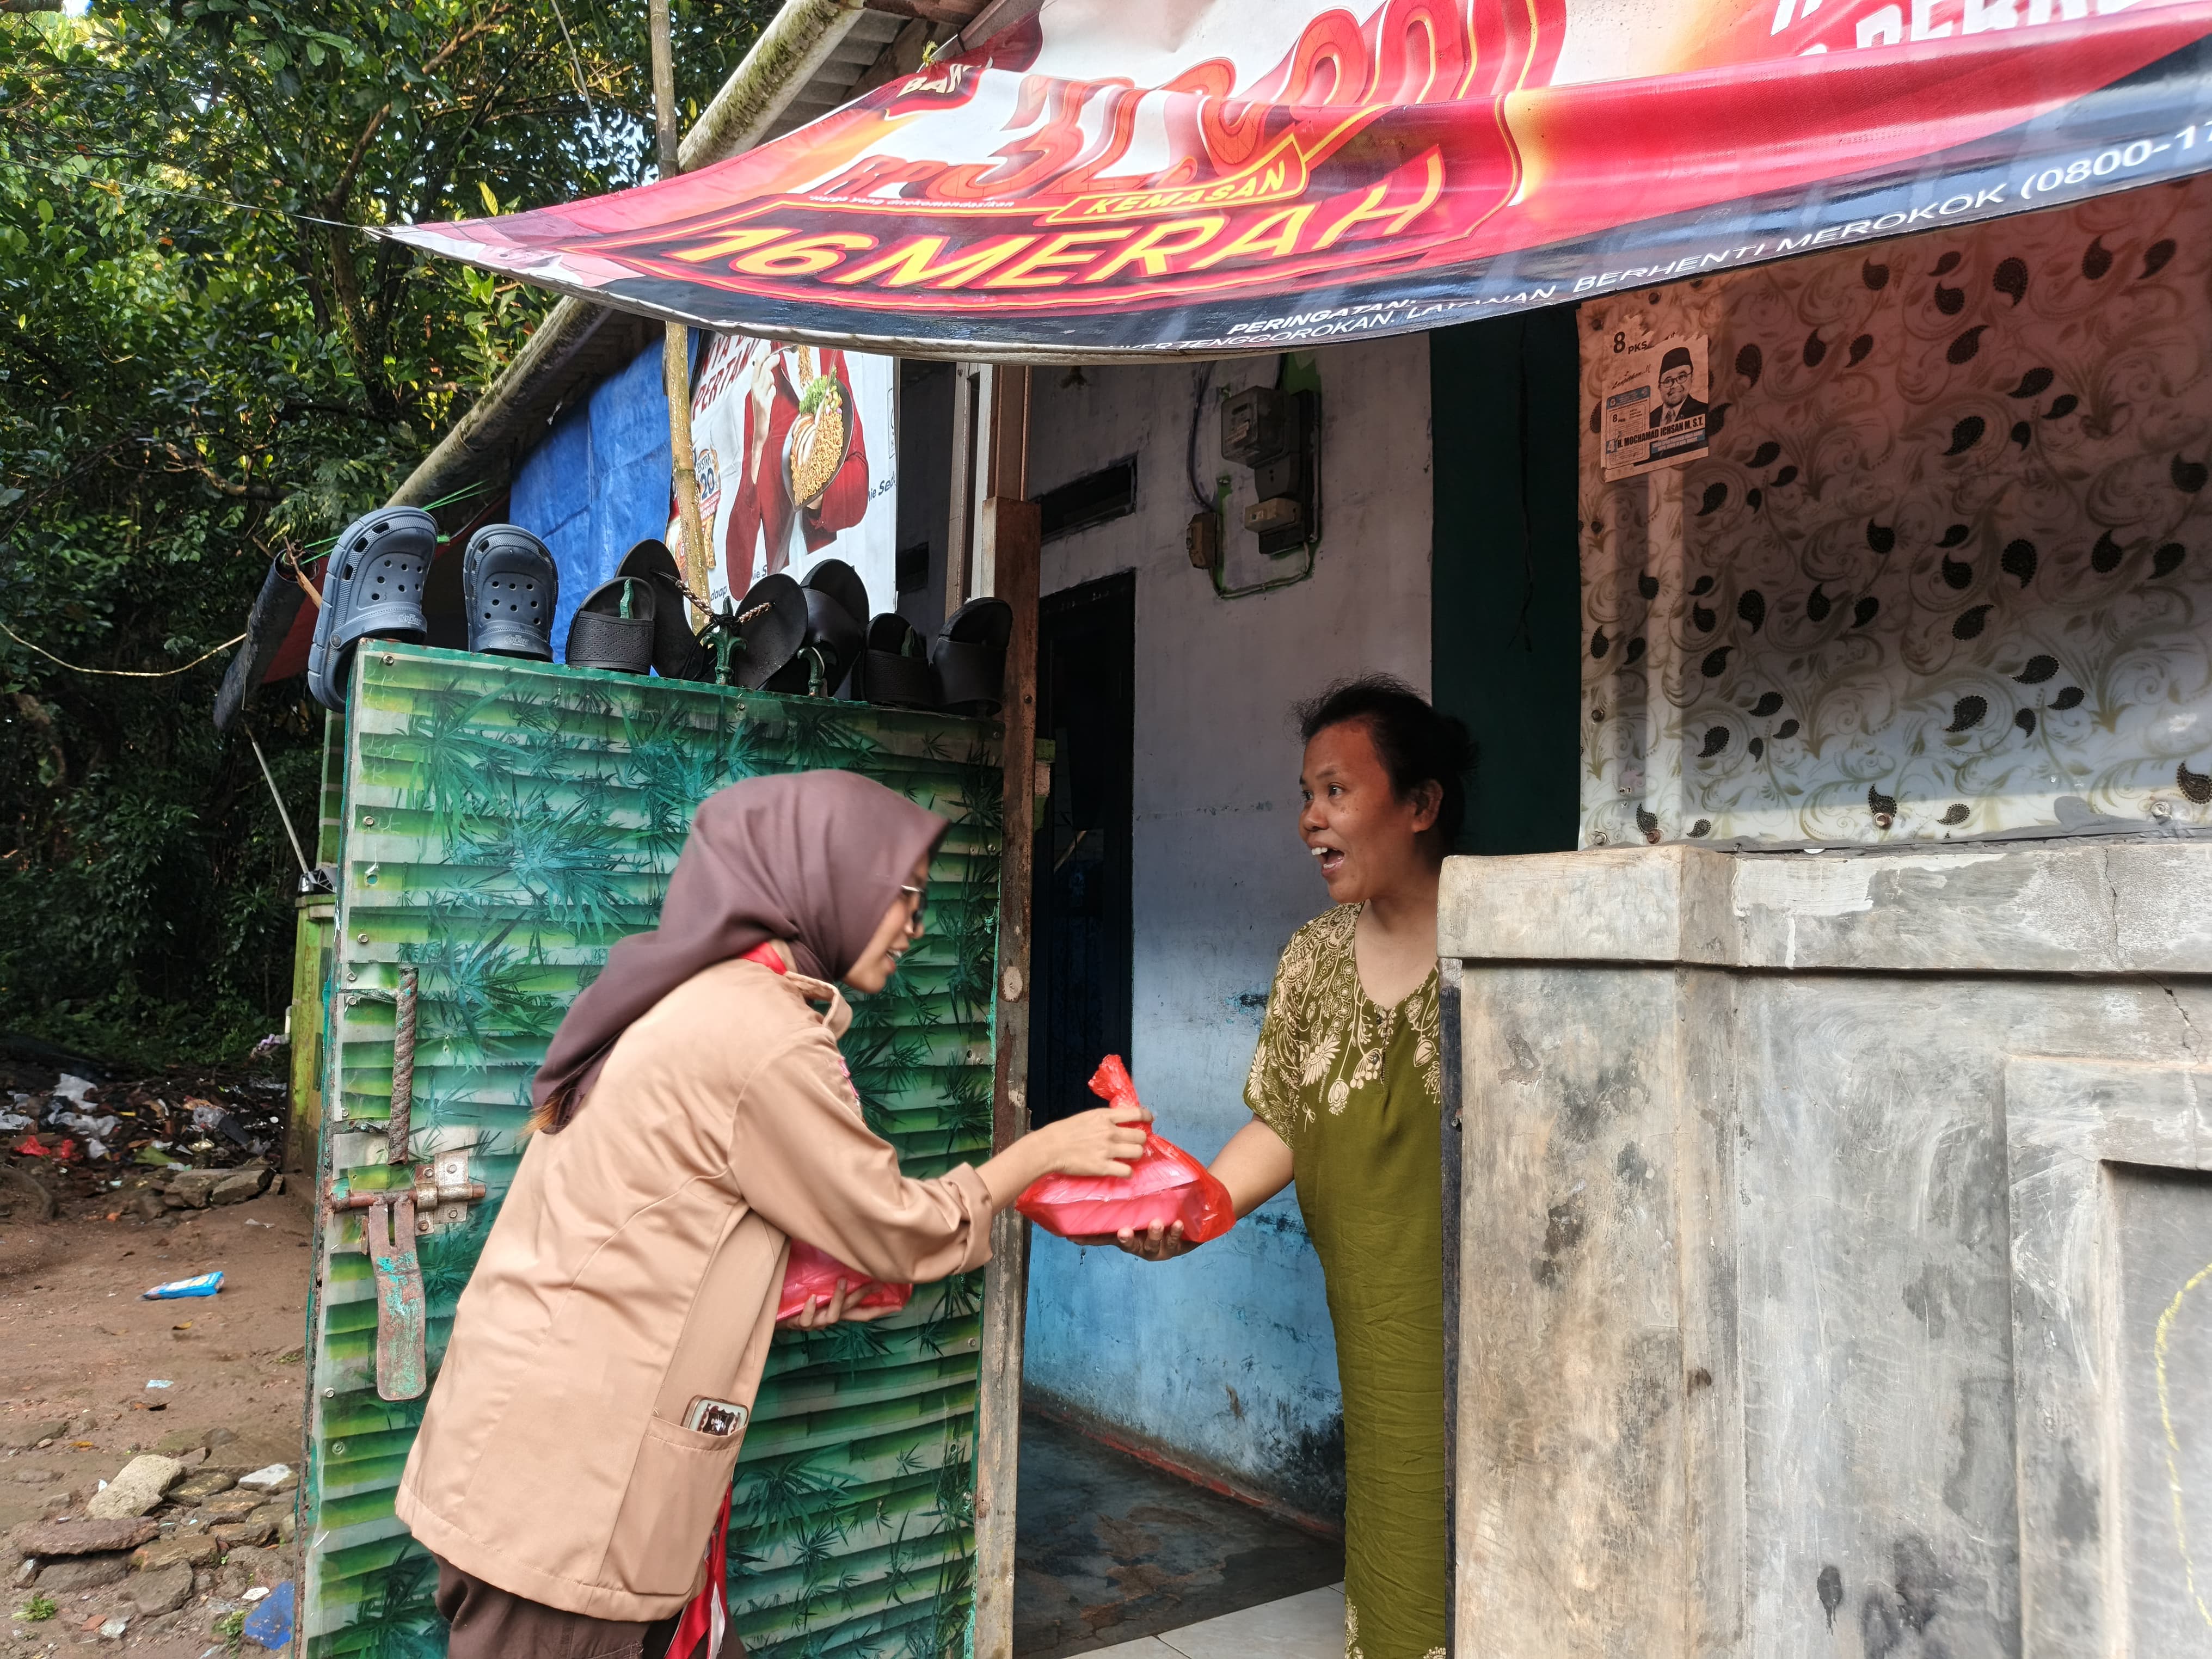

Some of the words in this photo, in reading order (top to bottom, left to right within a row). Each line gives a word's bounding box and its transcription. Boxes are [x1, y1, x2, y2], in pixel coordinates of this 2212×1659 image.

[1086, 159, 1286, 216] KEMASAN
[849, 196, 884, 206] yang
[665, 228, 877, 276] 16
[827, 146, 1445, 290] MERAH
[1572, 243, 1766, 293] BERHENTI
[1775, 182, 2008, 253] MEROKOK
[1613, 331, 1626, 354] 8
[1628, 340, 1648, 354] PKS
[1607, 440, 1615, 452] 4
[1624, 428, 1659, 446] MOCHAMAD
[1660, 422, 1683, 437] ICHSAN
[697, 453, 711, 474] EKSTRA
[700, 467, 715, 501] 20
